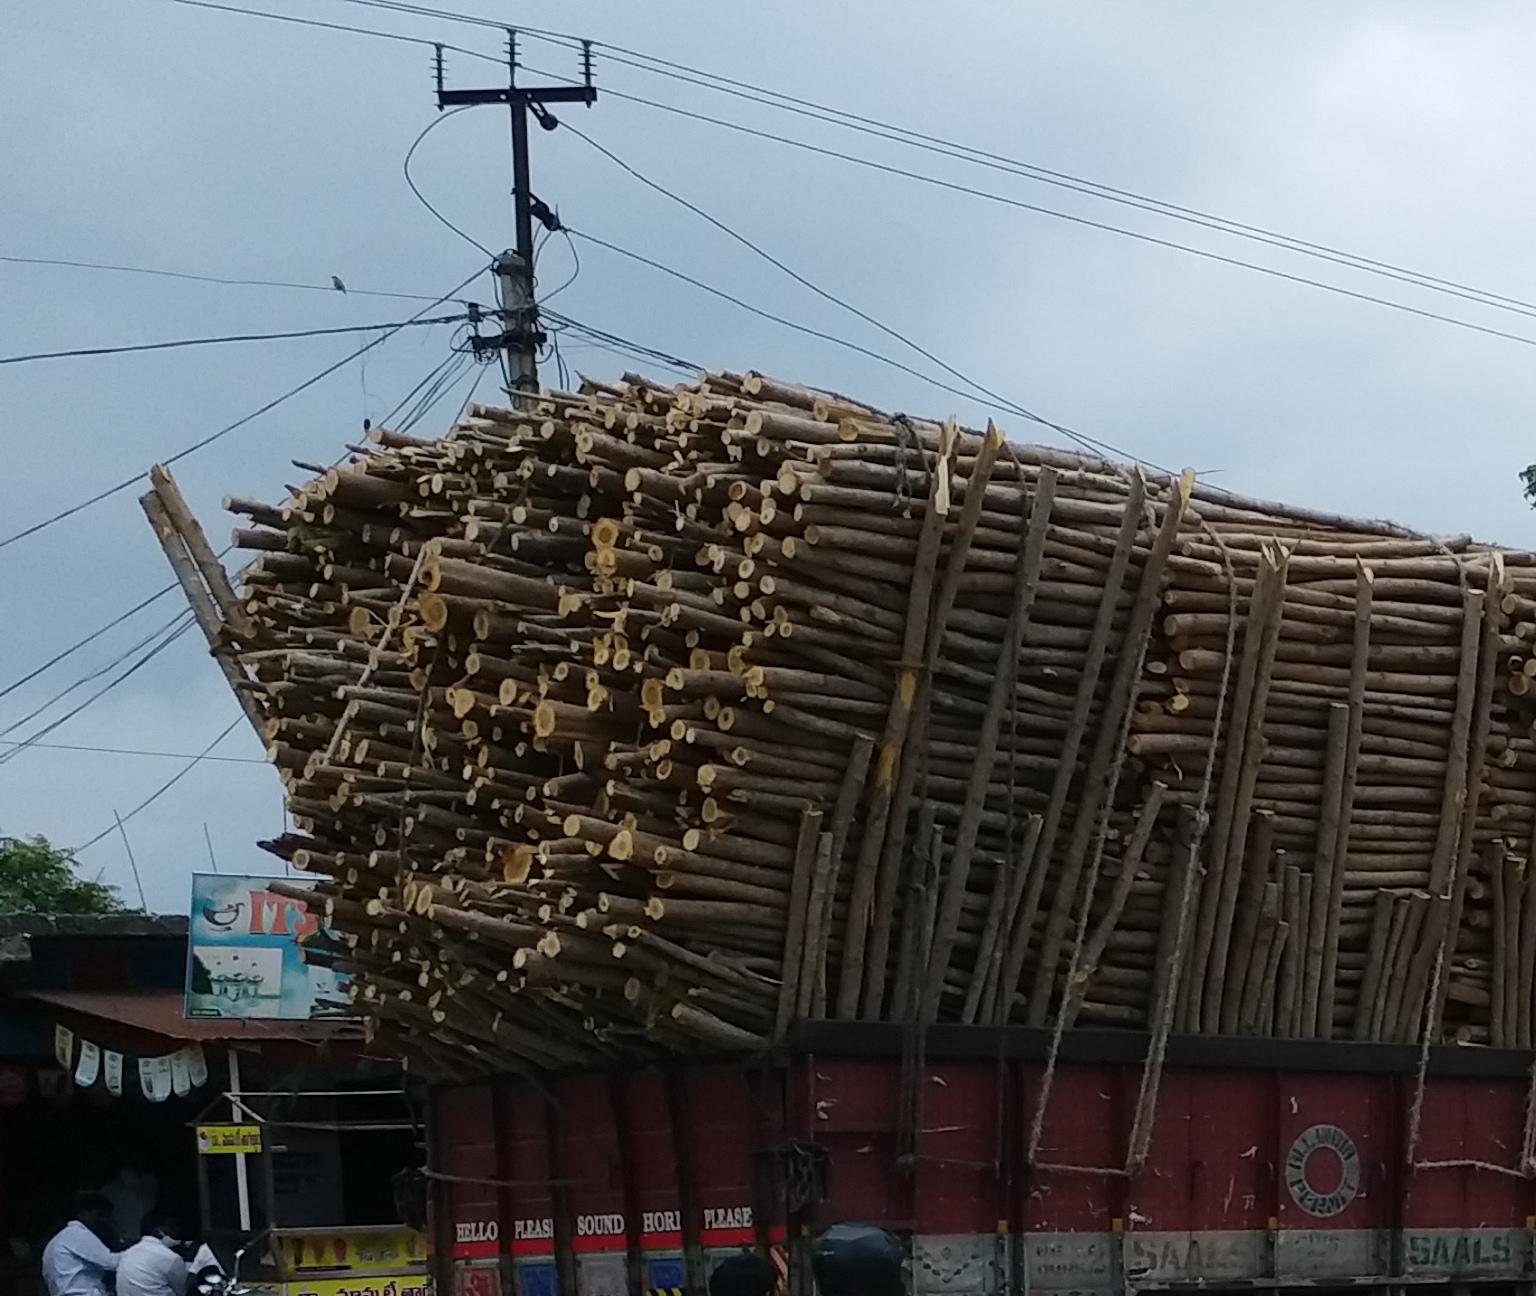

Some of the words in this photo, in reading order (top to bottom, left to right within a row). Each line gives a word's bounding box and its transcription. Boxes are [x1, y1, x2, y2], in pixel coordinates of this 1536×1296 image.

[455, 1219, 499, 1243] HELLO
[576, 1213, 625, 1236] SOUND
[703, 1206, 753, 1230] PLEASE
[1409, 1236, 1512, 1266] SAALS
